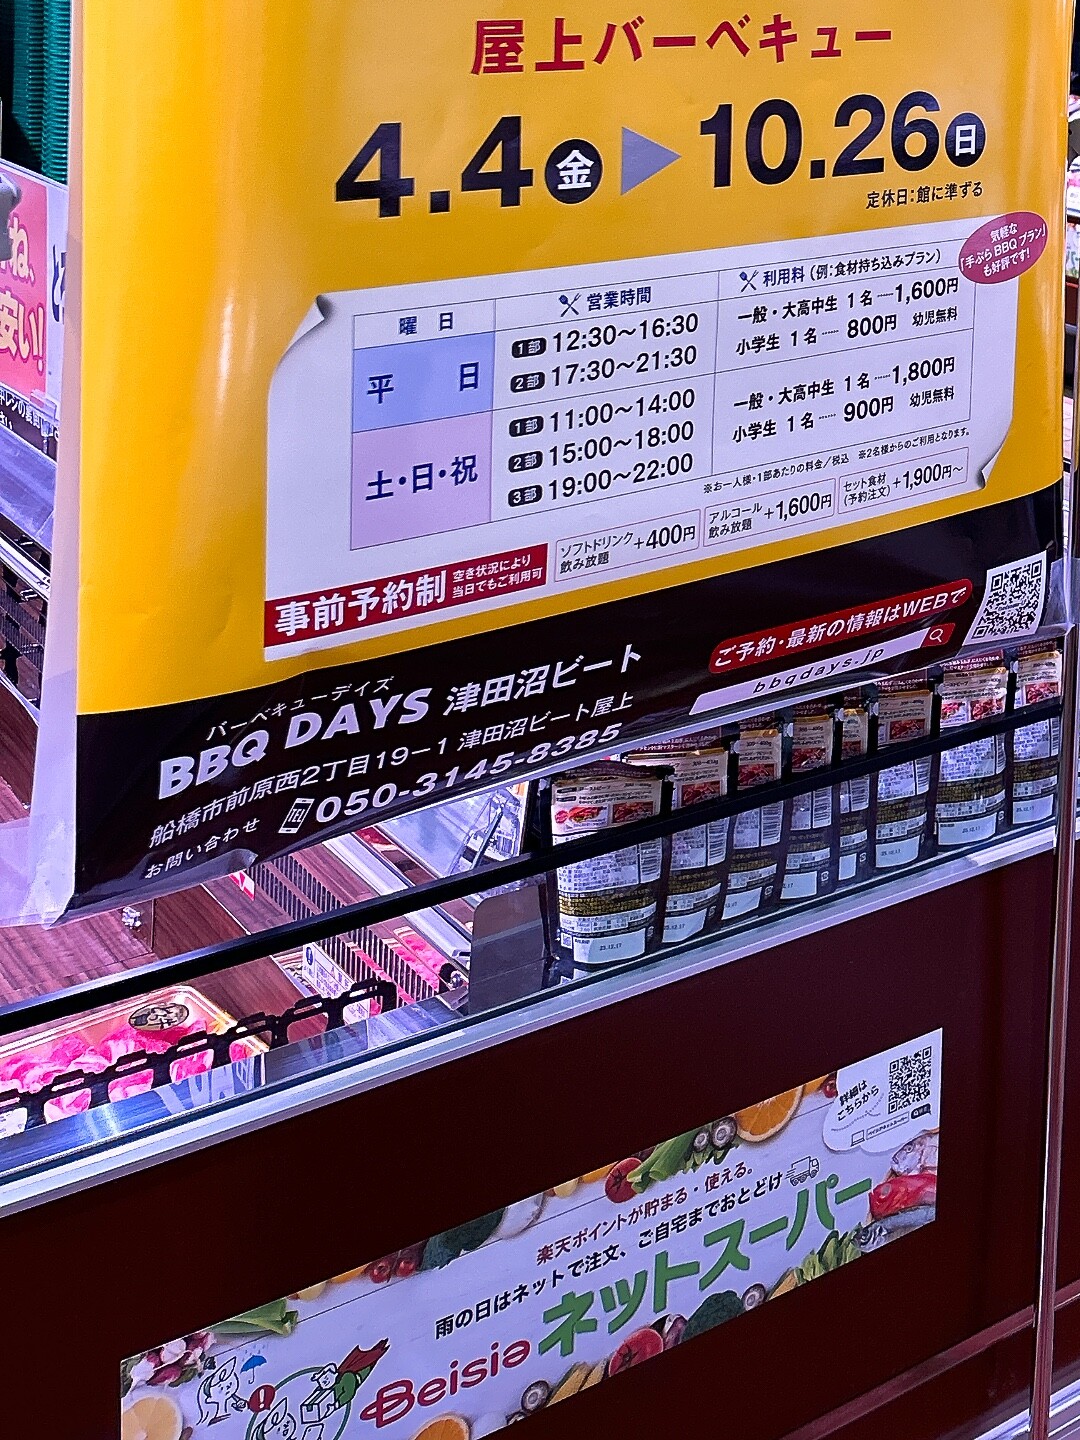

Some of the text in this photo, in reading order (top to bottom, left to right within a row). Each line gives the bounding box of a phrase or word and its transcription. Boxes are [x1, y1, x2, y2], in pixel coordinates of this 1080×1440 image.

[469, 12, 893, 76] 屋上バーベキュー
[334, 91, 979, 219] 4.4 金 10.26 日
[990, 222, 1018, 243] 気軽な
[763, 266, 805, 287] 利用料
[984, 248, 1030, 277] も好評です!
[586, 286, 652, 311] 営業時間
[737, 294, 838, 325] 一般・大高中生
[895, 276, 960, 305] 1,600円
[735, 332, 780, 357] 小学生
[846, 313, 897, 340] 800円
[912, 306, 958, 328] 幼児無料
[733, 378, 835, 412] 一般・大高中生
[892, 356, 955, 386] 1,800円
[732, 418, 777, 444] 小学生
[843, 396, 894, 423] 900円
[909, 385, 955, 409] 幼児無料
[844, 472, 887, 492] セット食材
[708, 518, 753, 539] 飲み放題
[709, 502, 763, 524] アルコール
[452, 553, 532, 584] 空き状況により
[559, 551, 610, 573] 飲み放題
[560, 531, 634, 557] ソフトドリンク
[275, 570, 447, 637] 事前予約制
[452, 568, 544, 599] 当日でもご利用可
[752, 646, 886, 696] bbqdays.jp
[158, 643, 642, 800] BBQ DAYS 津田沼ビート
[206, 675, 396, 741] バーベキューデイズ
[456, 691, 634, 753] 津田沼ビート屋上
[315, 722, 624, 823] 050-3145-8385
[145, 817, 261, 879] お問い合わせ
[837, 1085, 880, 1121] こちらから
[839, 1080, 868, 1106] 詳細は
[359, 1173, 873, 1428] Beisia ネットスーパー
